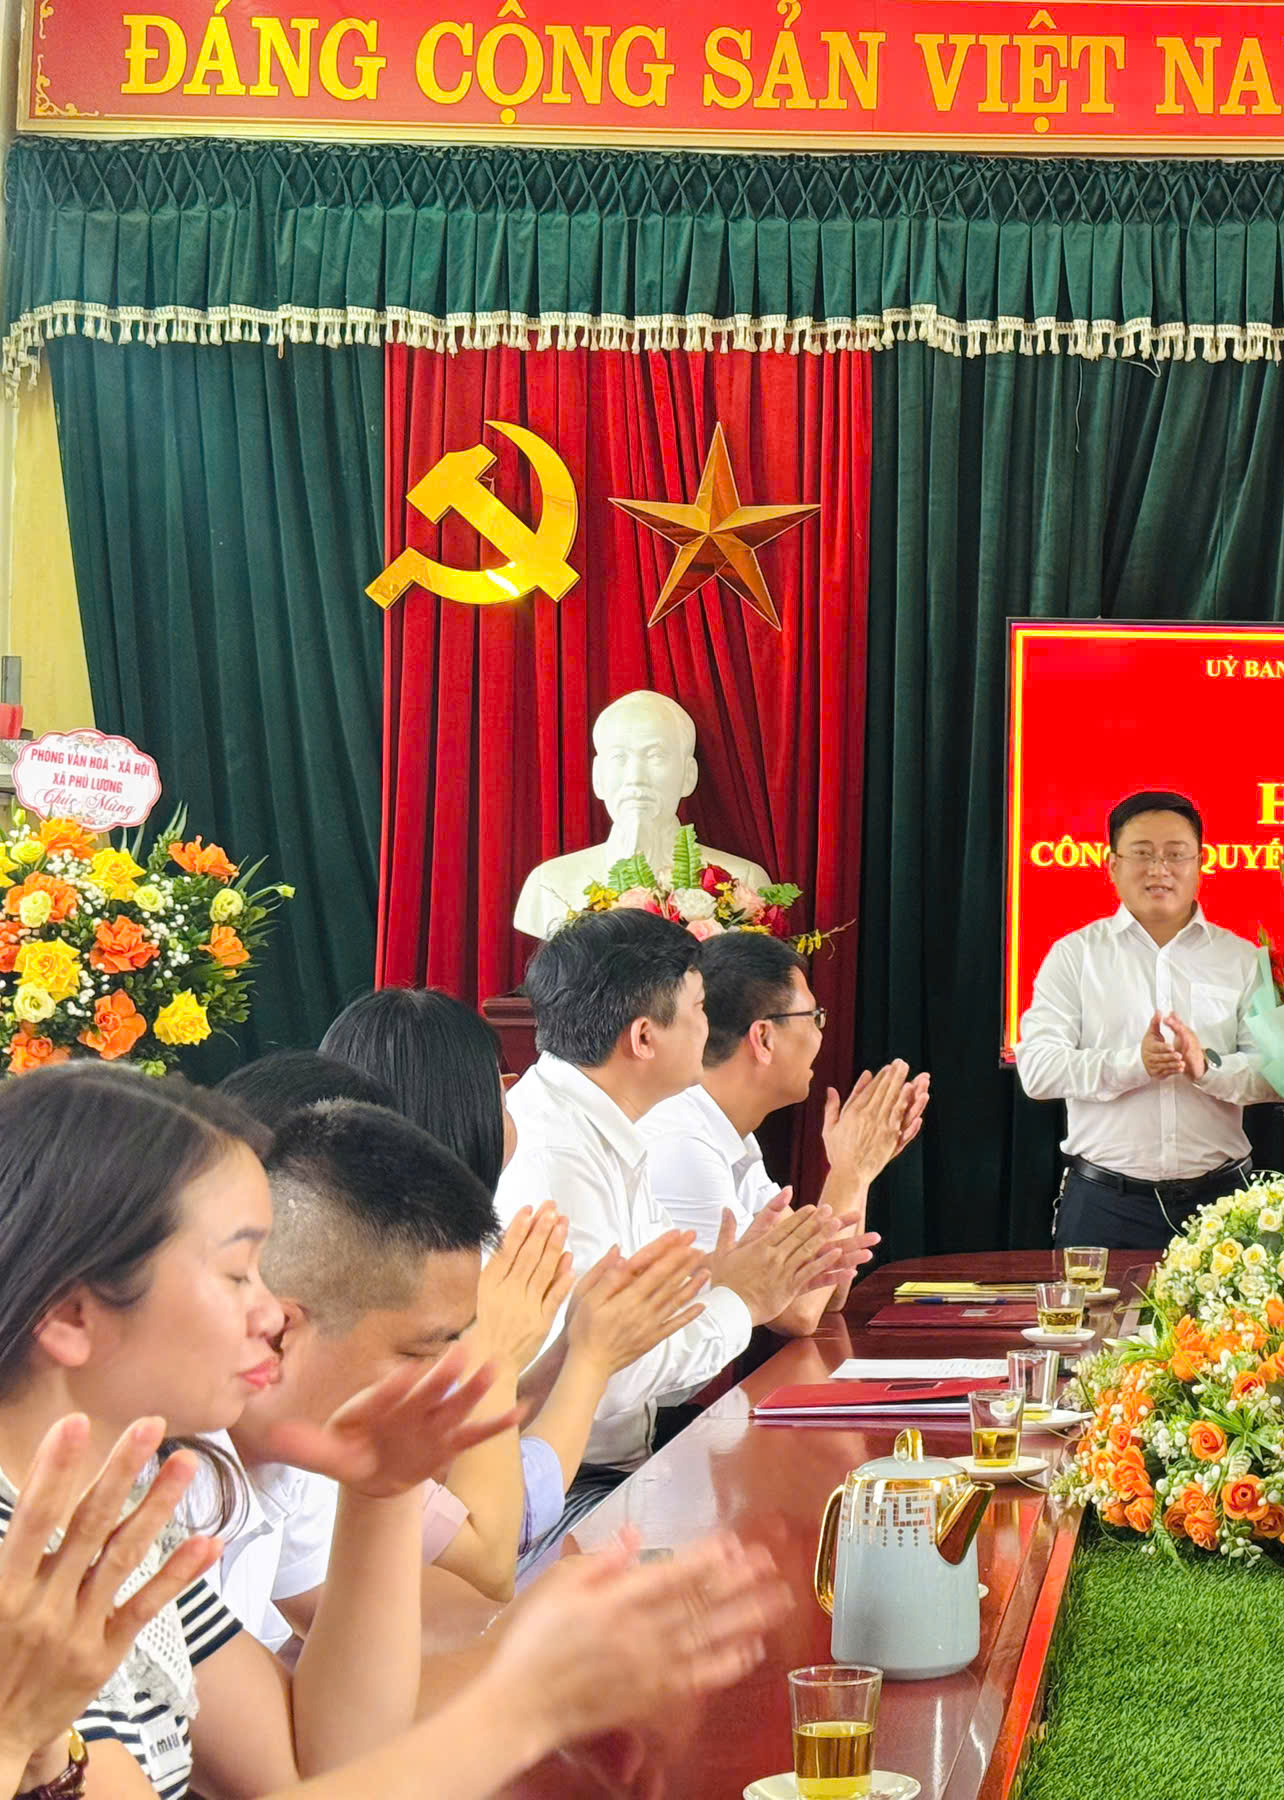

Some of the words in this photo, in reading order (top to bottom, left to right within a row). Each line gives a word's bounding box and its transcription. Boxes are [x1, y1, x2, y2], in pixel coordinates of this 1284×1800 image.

[414, 0, 676, 125] CỘNG
[703, 0, 887, 110] SẢN
[915, 9, 1125, 133] VIỆT
[1031, 834, 1111, 868] CÔN
